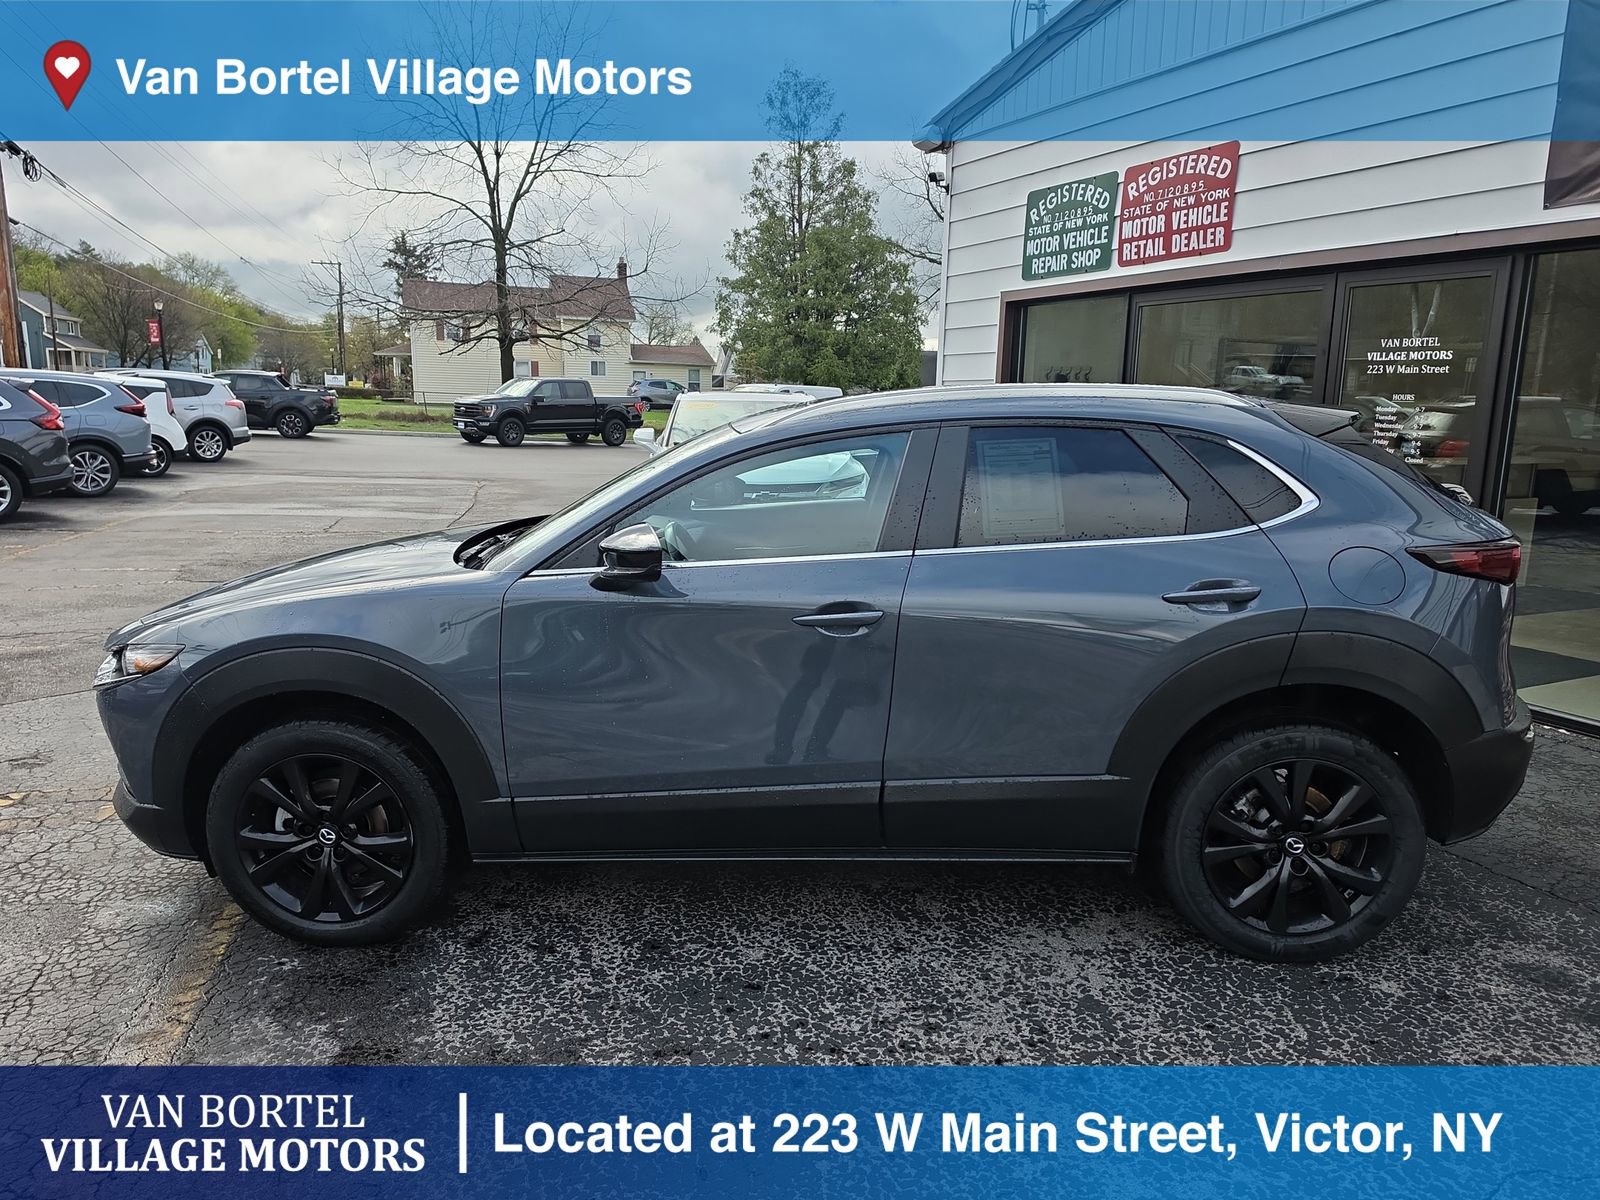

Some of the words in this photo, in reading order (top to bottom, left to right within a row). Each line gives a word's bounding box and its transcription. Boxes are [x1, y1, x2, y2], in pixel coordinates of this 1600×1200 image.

[1128, 154, 1231, 200] REGISTERED
[1158, 180, 1205, 199] 7120895
[1030, 183, 1110, 224] REGISTERED
[1055, 205, 1093, 221] 7120895
[1123, 204, 1152, 218] STATE
[1156, 200, 1169, 211] OF
[1174, 195, 1196, 208] NEW
[1201, 187, 1230, 202] YORK
[1029, 224, 1051, 236] STATE
[1053, 222, 1063, 231] OF
[1066, 218, 1083, 229] NEW
[1086, 212, 1109, 225] YORK
[1122, 214, 1166, 239] MOTOR
[1172, 202, 1228, 230] VEHICLE
[1026, 235, 1060, 256] MOTOR
[1063, 226, 1109, 249] VEHICLE
[1123, 237, 1166, 261] RETAIL
[1172, 227, 1225, 253] DEALER
[1032, 253, 1068, 274] REPAIR
[1071, 248, 1101, 268] SHOP
[1381, 339, 1400, 347] VAN
[1402, 337, 1440, 347] BORTEL
[1367, 351, 1407, 360] VILLAGE
[1409, 350, 1453, 360] MOTORS
[1367, 365, 1383, 374] 223
[1386, 365, 1395, 374] W
[1397, 365, 1419, 374] Main
[1421, 364, 1450, 374] Street
[1373, 430, 1398, 438] Thursday
[1374, 422, 1404, 430] Wednesday
